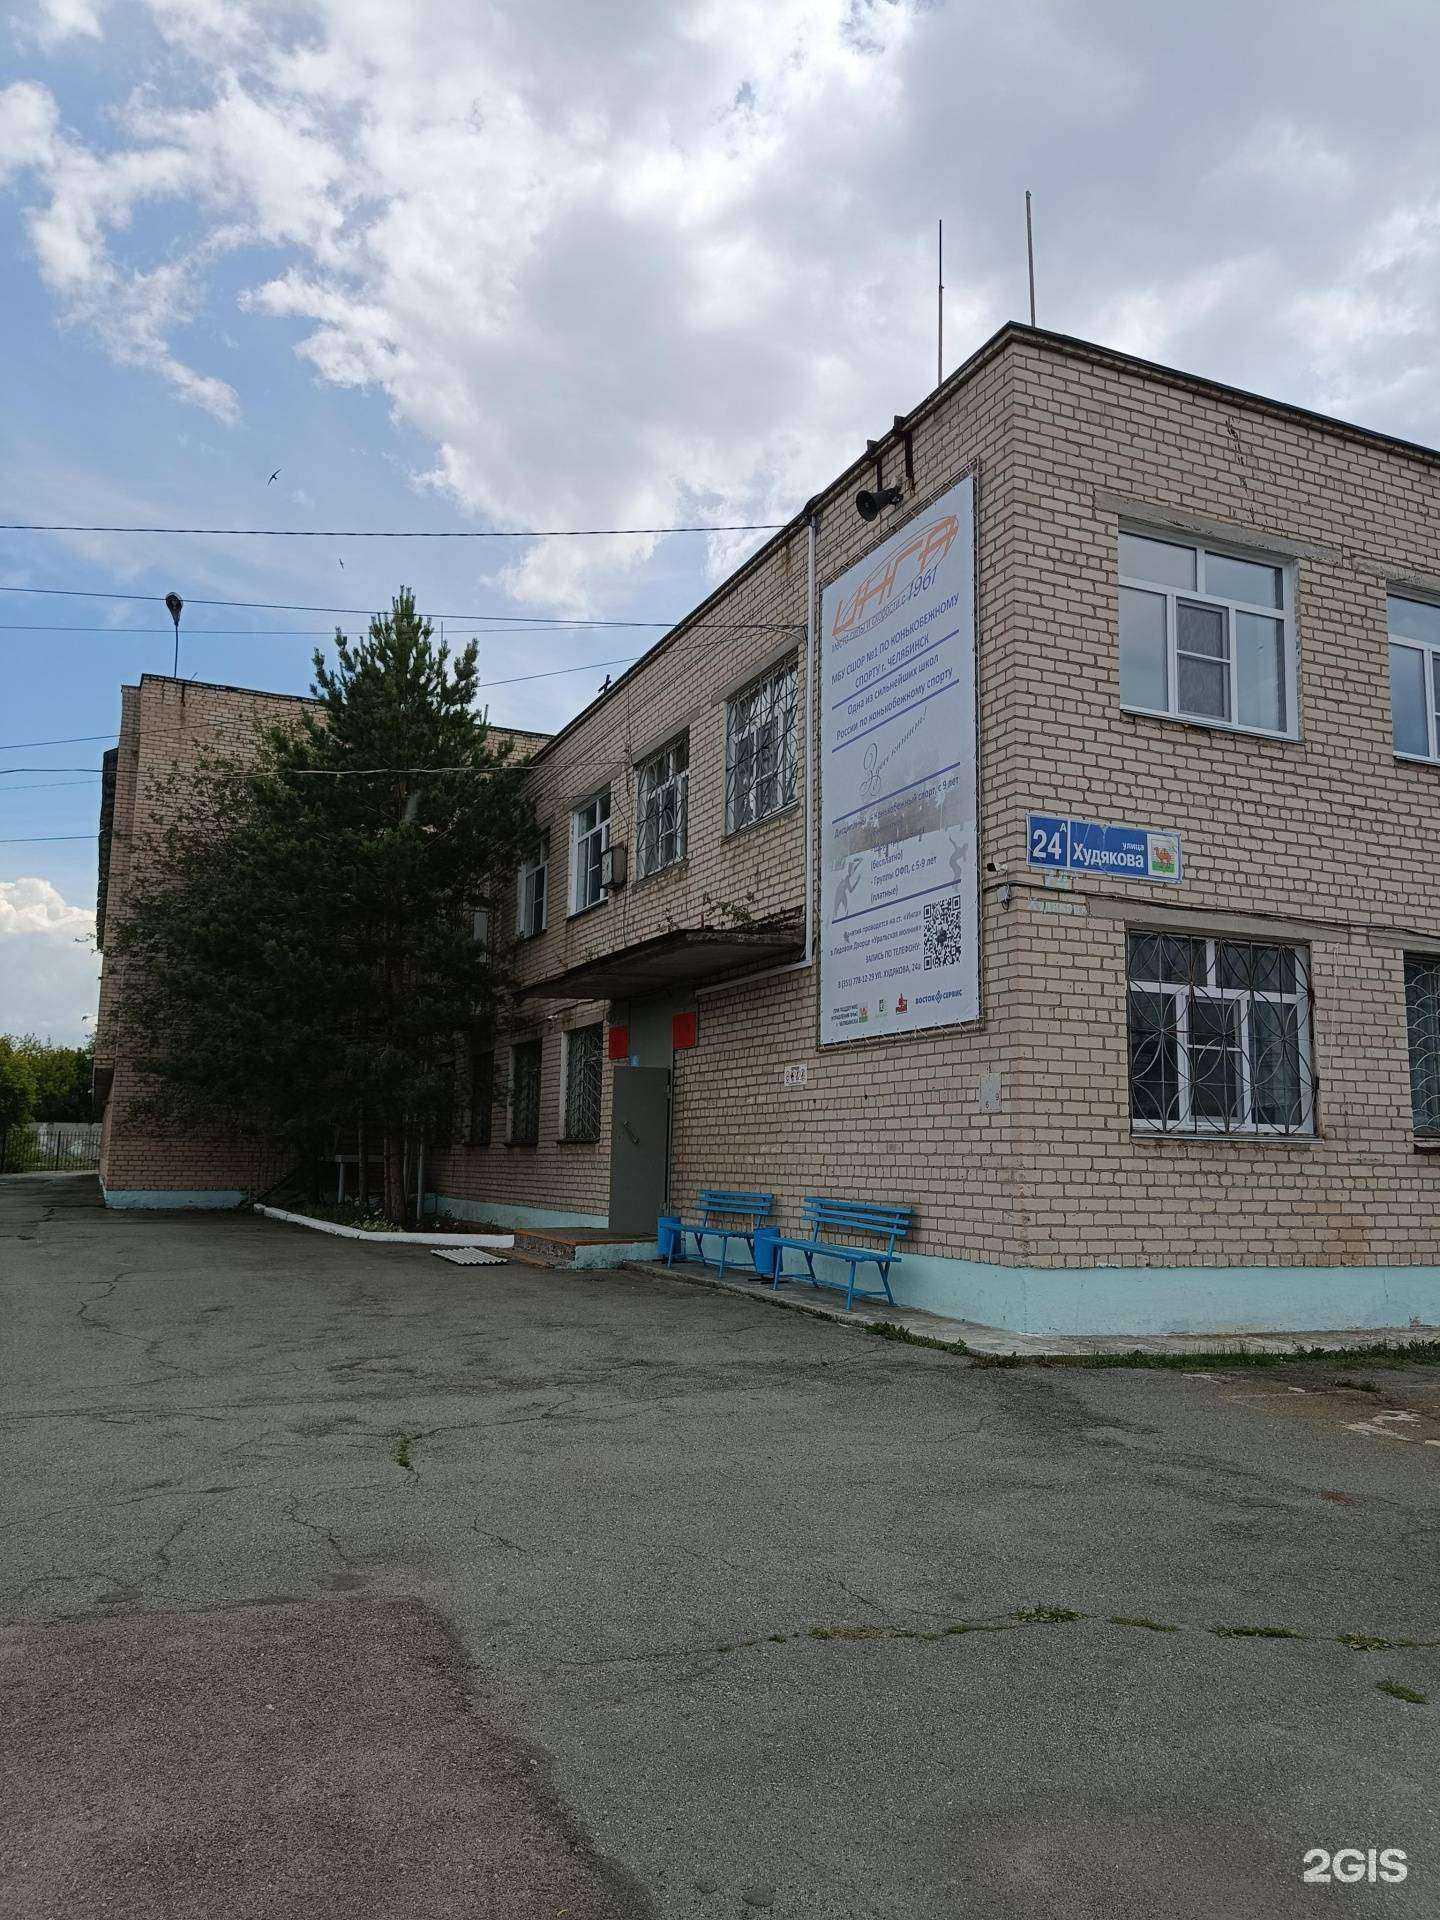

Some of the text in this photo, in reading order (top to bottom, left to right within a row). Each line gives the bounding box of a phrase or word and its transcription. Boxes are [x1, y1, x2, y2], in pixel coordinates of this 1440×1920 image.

[908, 565, 938, 600] 1961
[832, 592, 960, 685] МБУ СШОР №1 ПО КОНЬКОБЕЖНОМУ
[855, 664, 881, 688] СПОРТУ
[888, 633, 929, 666] ЧЕЛЯБИНСК
[847, 654, 939, 717] Одна из сильнейших школ
[836, 667, 953, 741] России по конькобежному спорту
[1032, 829, 1062, 860] 24
[1073, 842, 1145, 869] Худякова
[1121, 842, 1145, 852] улица
[915, 996, 935, 1005] ВОСТОК
